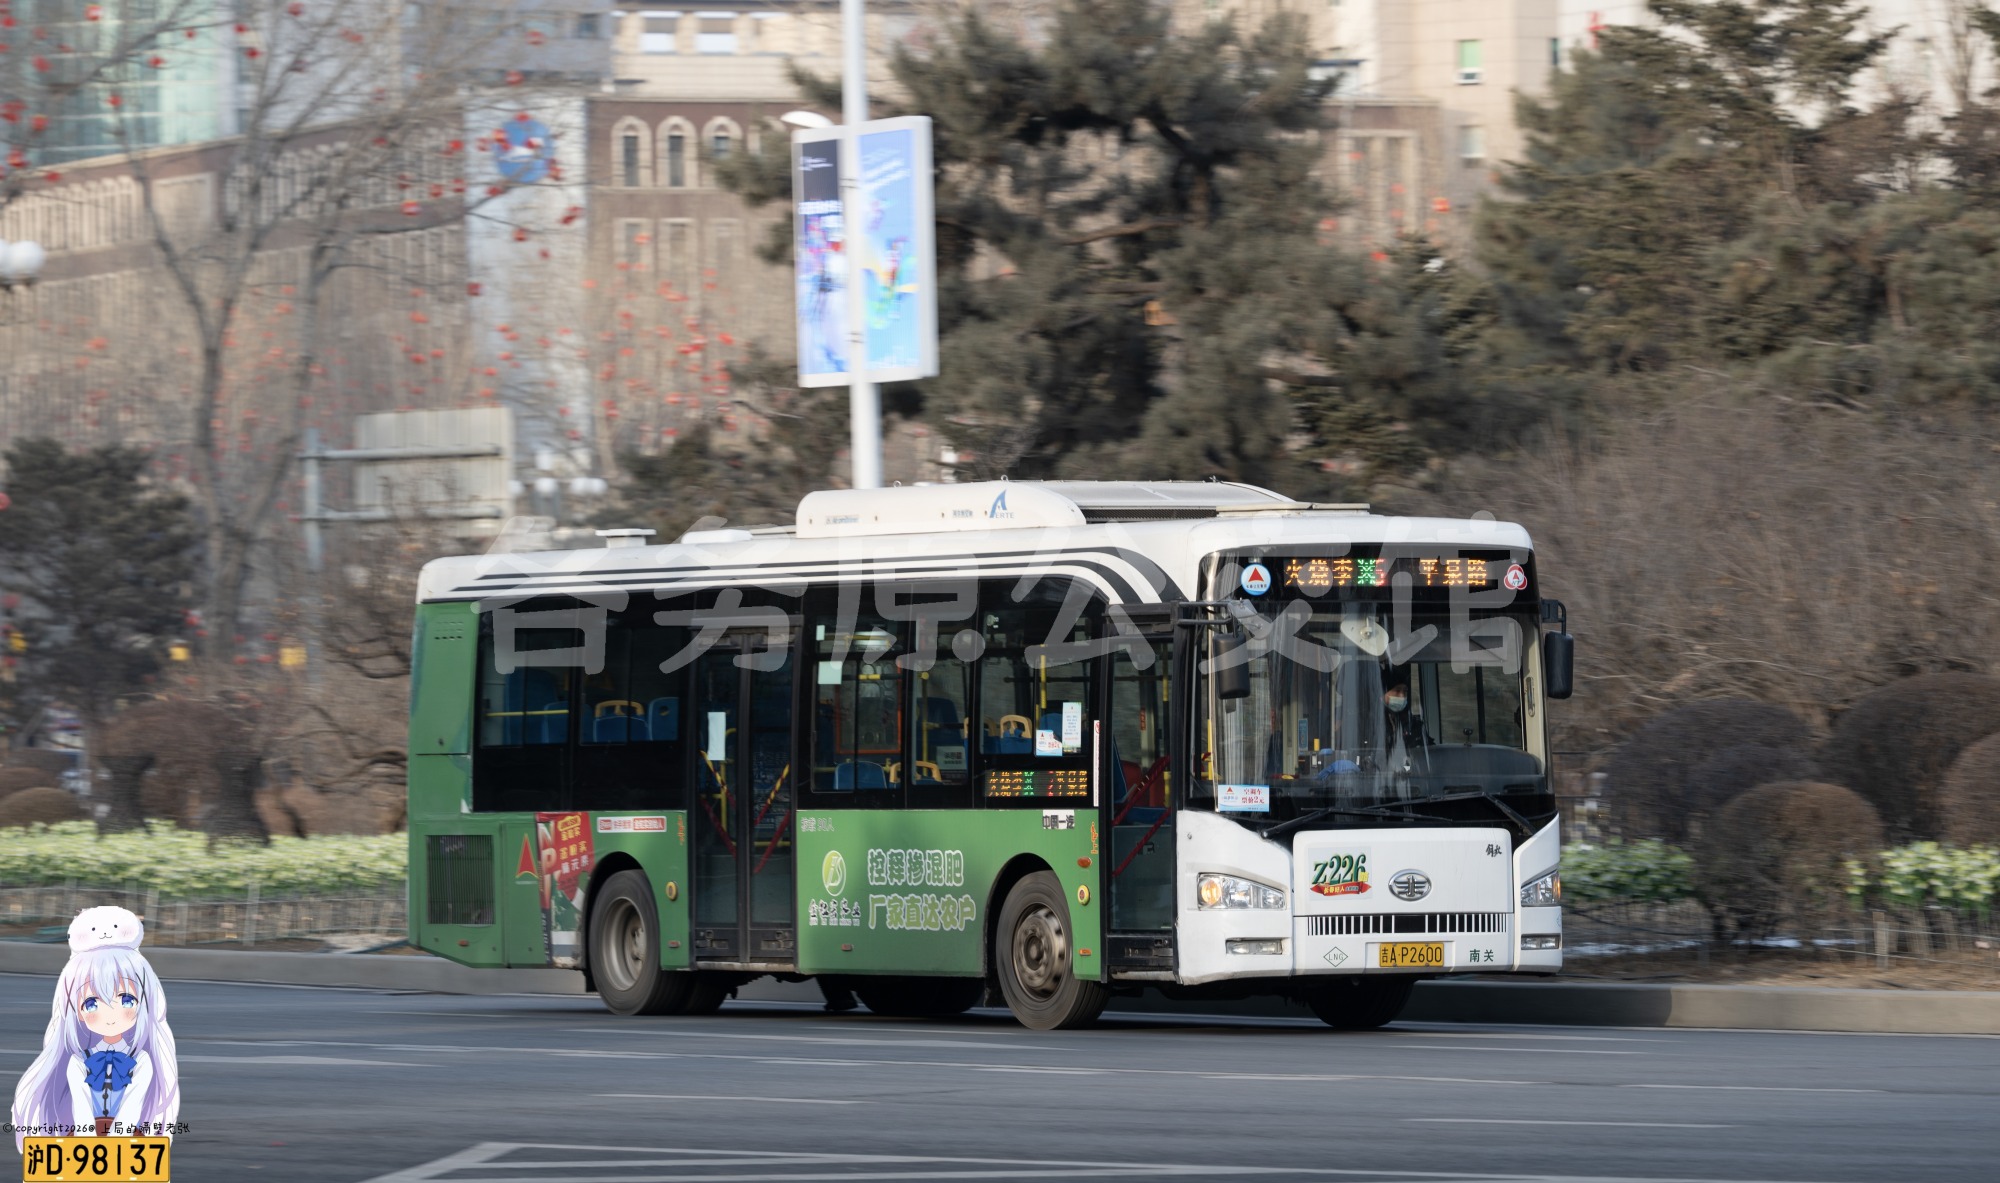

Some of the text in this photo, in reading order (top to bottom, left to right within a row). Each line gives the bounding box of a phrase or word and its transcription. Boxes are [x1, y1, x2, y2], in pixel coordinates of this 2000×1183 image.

[1042, 814, 1075, 830] 中国一汽
[867, 848, 964, 887] 控释掺混肥
[1311, 853, 1367, 886] Z226
[868, 893, 976, 931] 厂家直达农户
[1328, 952, 1344, 961] LNG
[1381, 946, 1442, 964] 吉A·P2600
[1469, 948, 1495, 963] 南关
